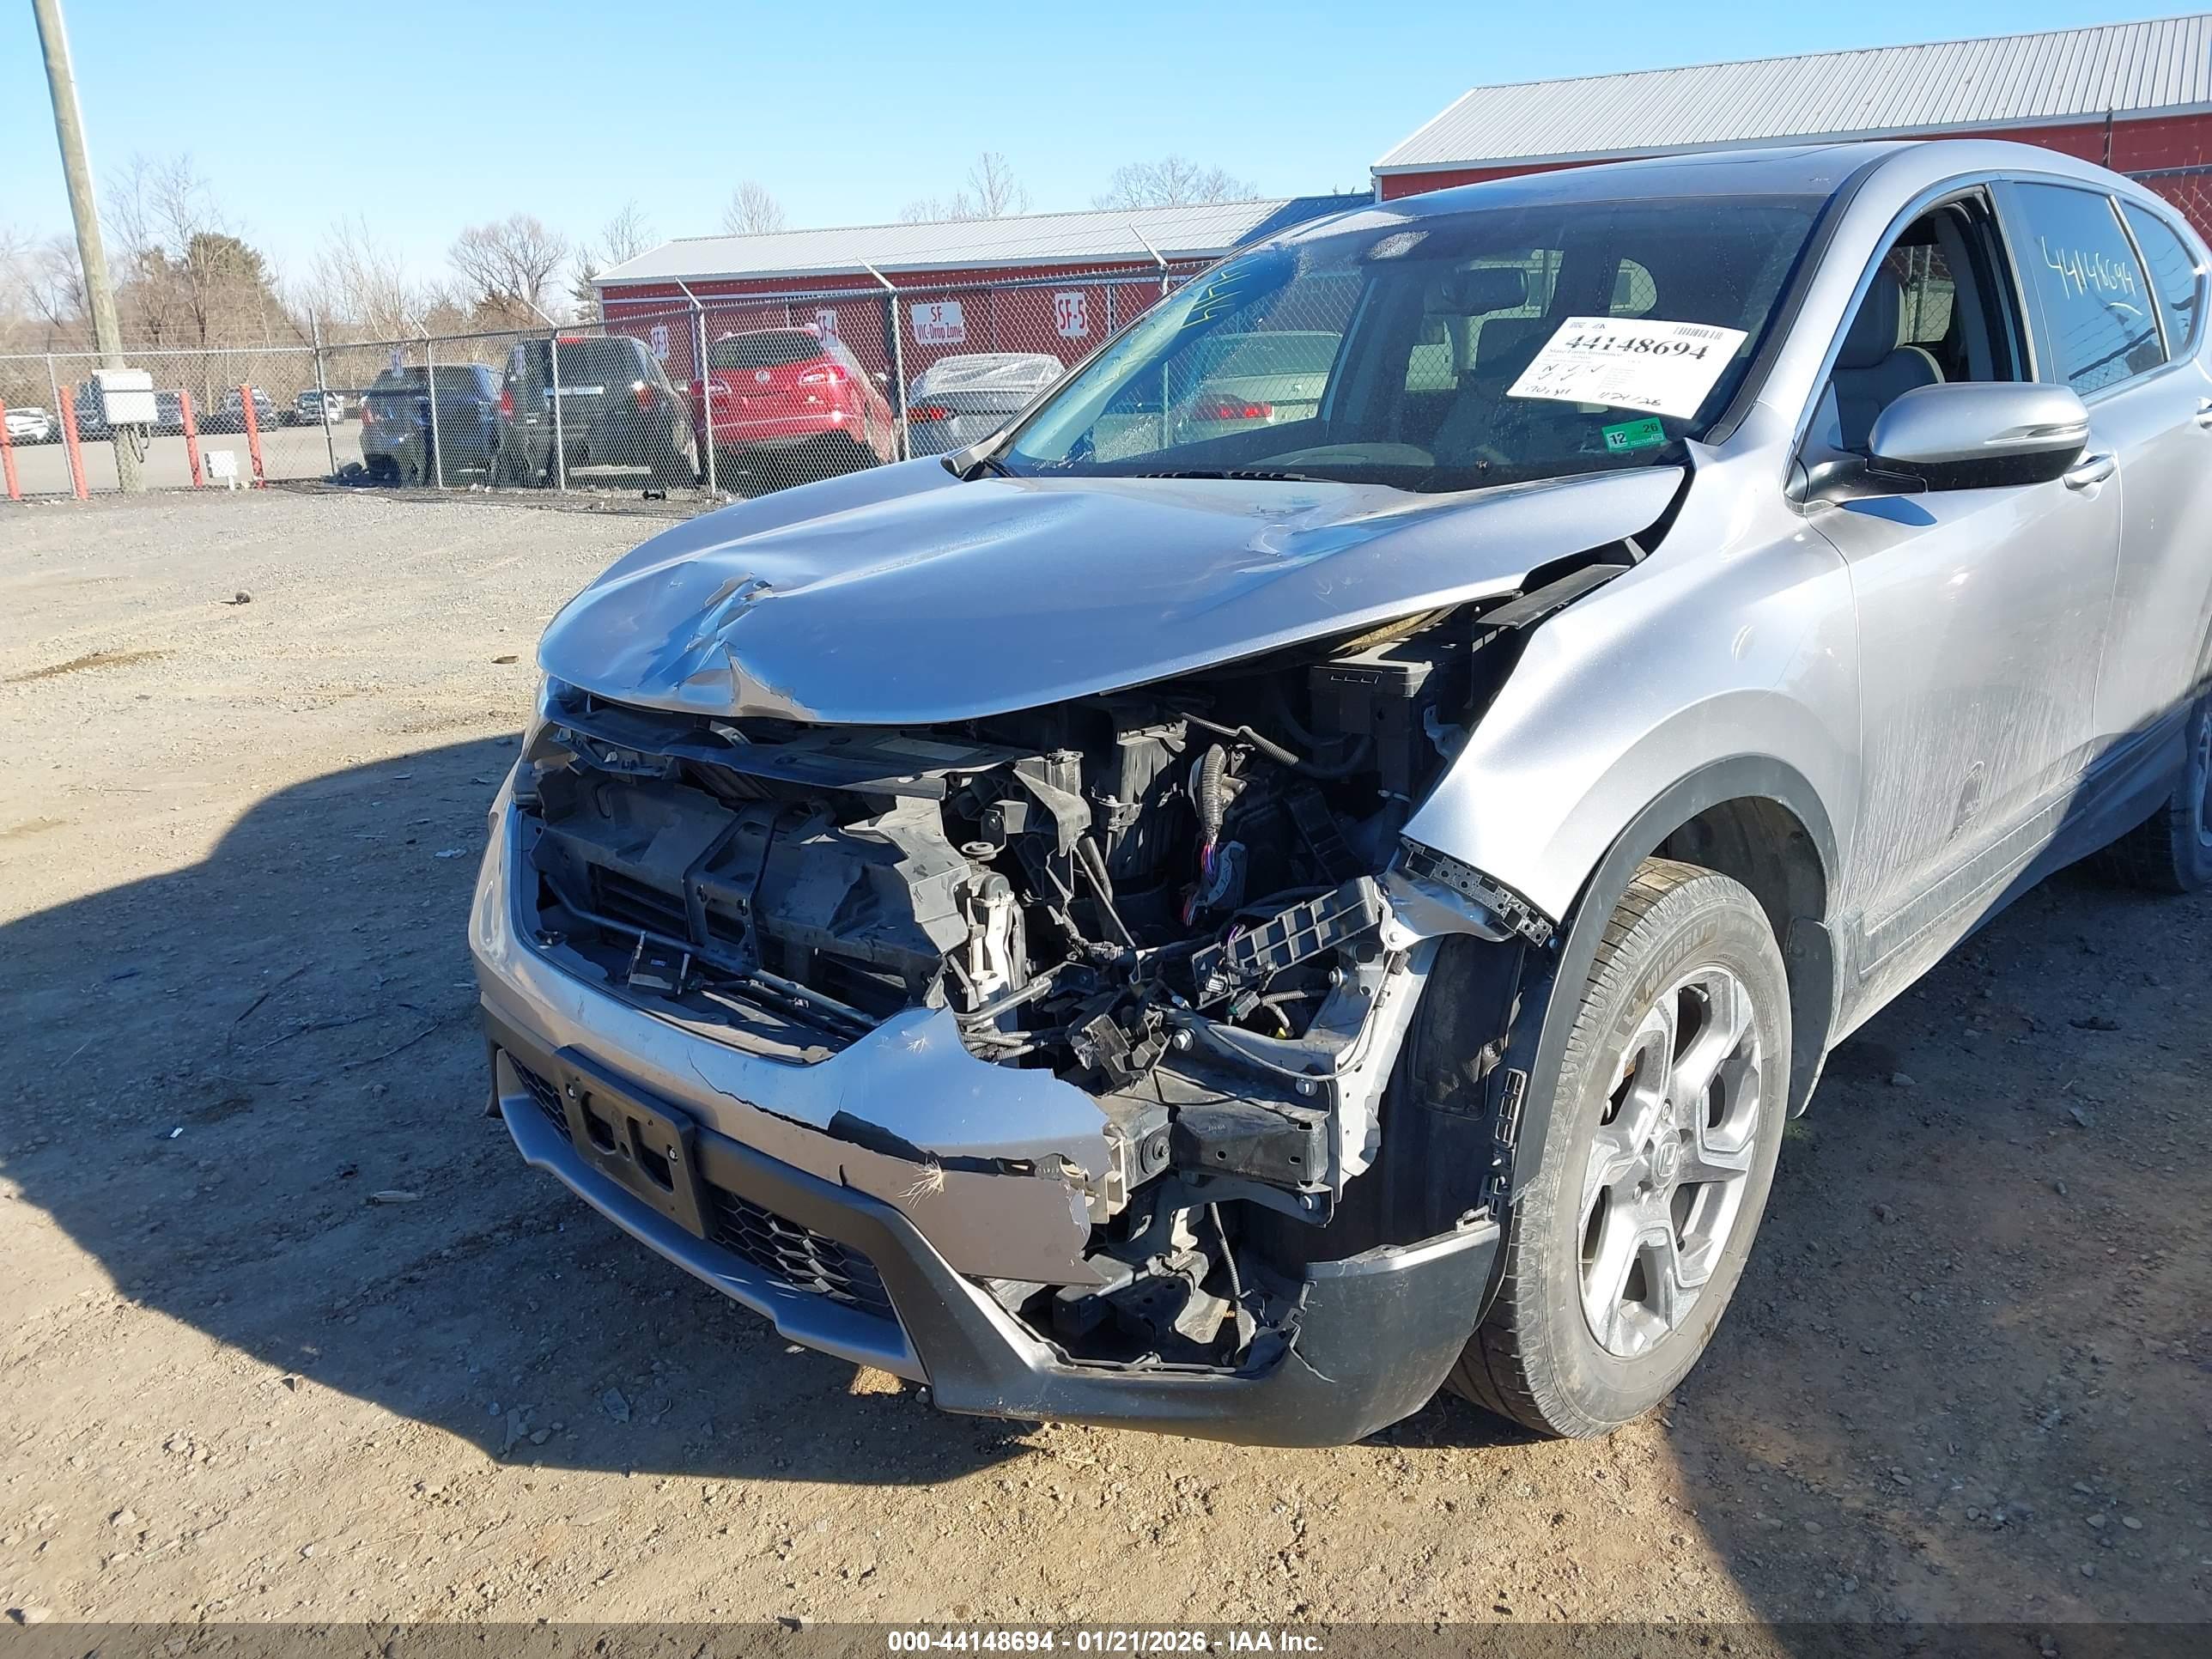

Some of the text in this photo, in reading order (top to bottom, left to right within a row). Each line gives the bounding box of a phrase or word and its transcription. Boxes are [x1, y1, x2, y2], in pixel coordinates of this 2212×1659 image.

[2041, 235, 2137, 299] 44148694
[931, 306, 943, 322] SF
[1058, 298, 1085, 330] SF-5
[817, 315, 837, 342] SF-4
[916, 322, 963, 341] VIC-Drop Zone
[653, 331, 667, 354] SF-3
[1565, 335, 1709, 360] 44148694
[1609, 432, 1627, 445] 12
[1643, 422, 1658, 434] 26
